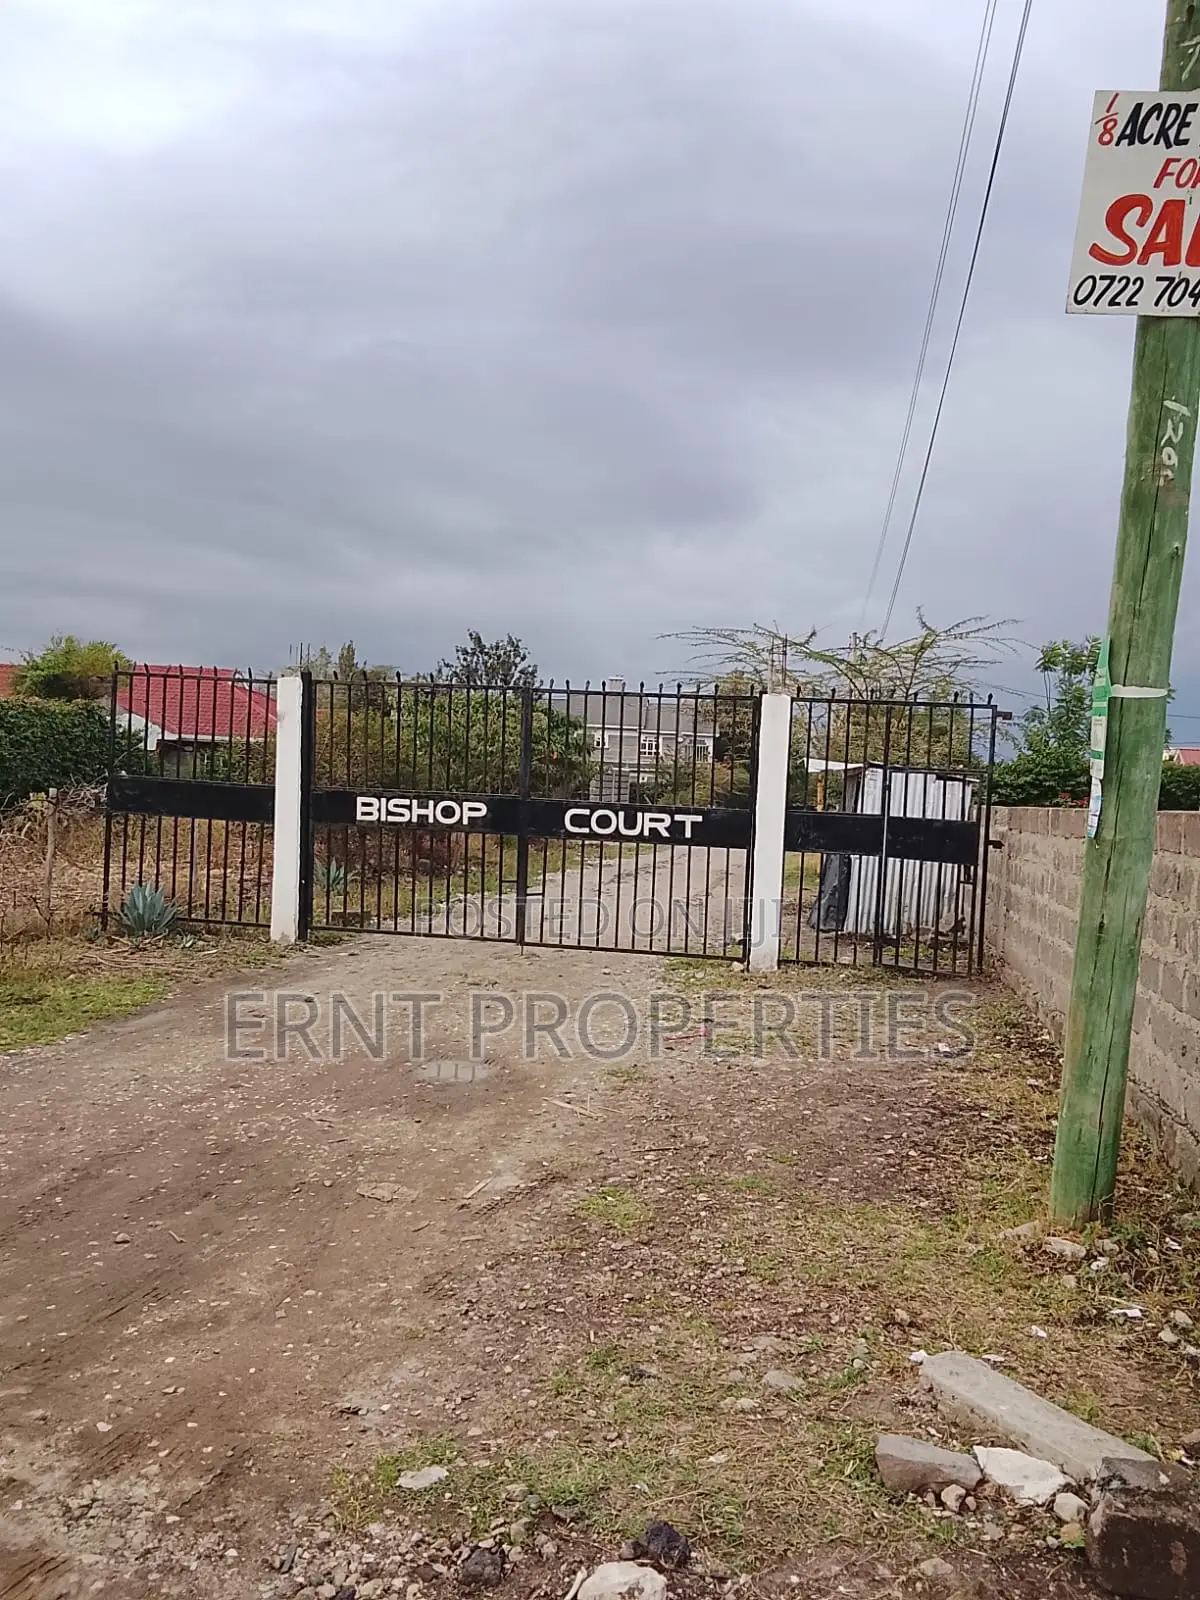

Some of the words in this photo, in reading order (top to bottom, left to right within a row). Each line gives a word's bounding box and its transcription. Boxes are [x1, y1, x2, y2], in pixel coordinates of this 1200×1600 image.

[1115, 101, 1199, 149] ACRE
[1073, 274, 1146, 307] 0722
[355, 796, 488, 826] BISHOP
[563, 808, 703, 838] COURT
